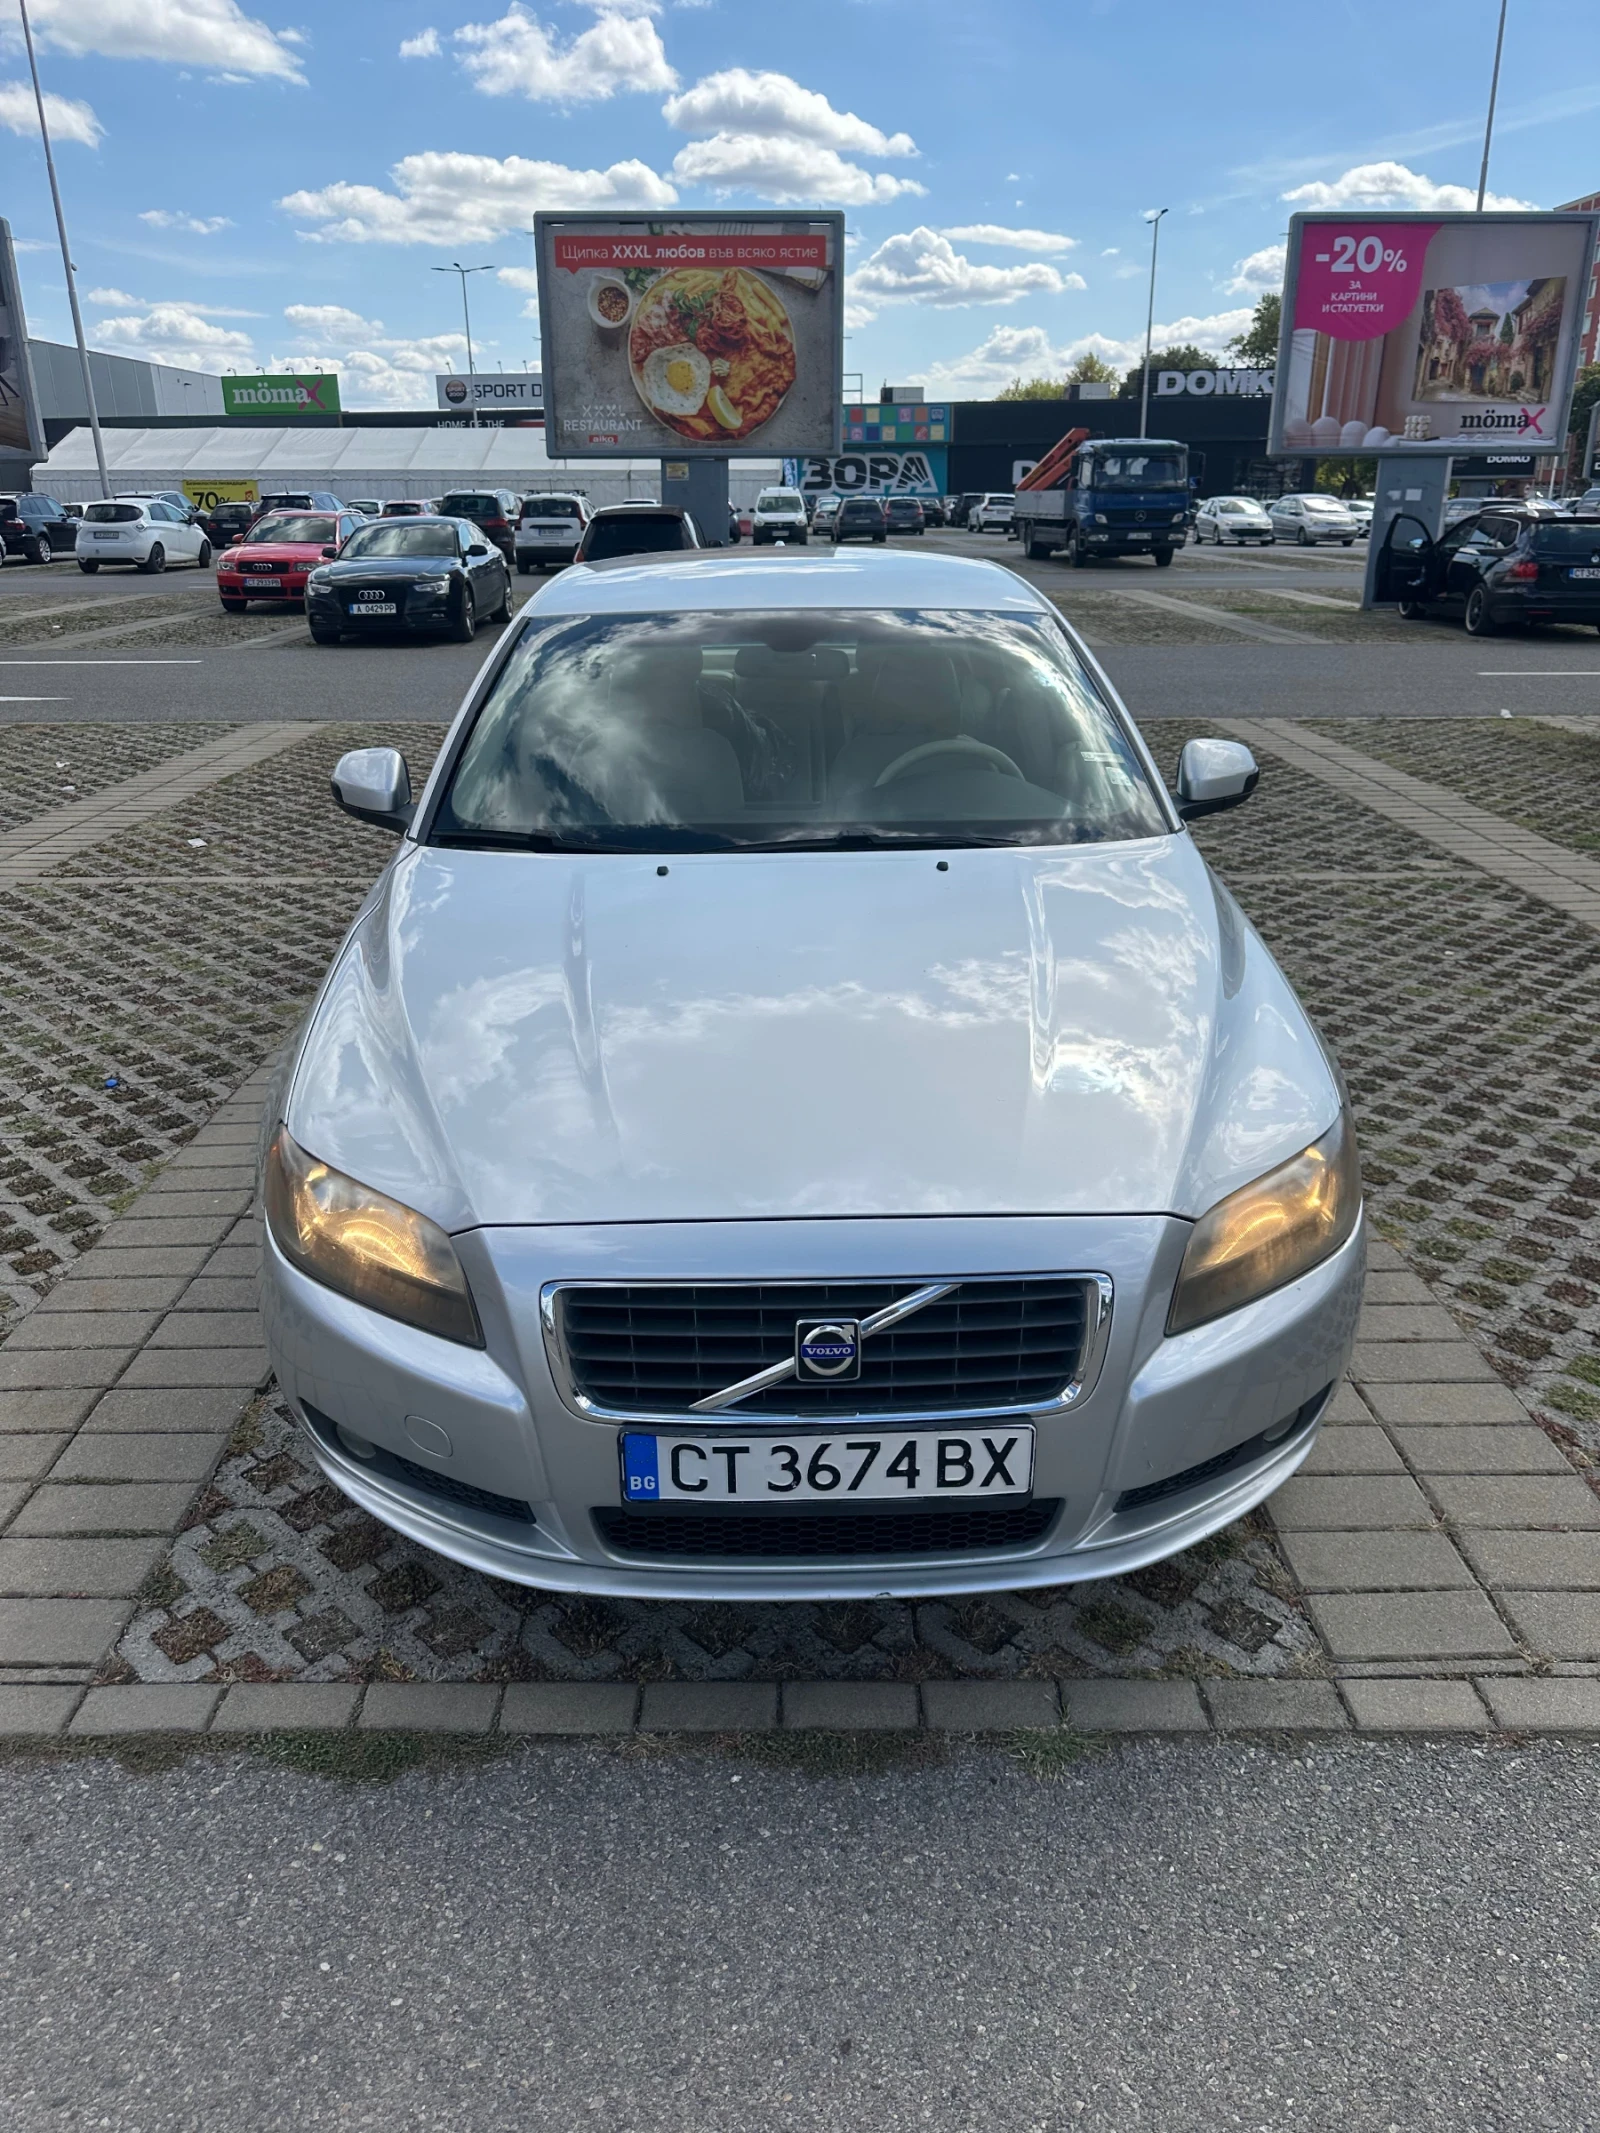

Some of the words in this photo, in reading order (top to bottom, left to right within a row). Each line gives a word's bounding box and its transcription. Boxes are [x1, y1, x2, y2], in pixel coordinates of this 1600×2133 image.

[562, 245, 608, 261] Щипка
[612, 245, 652, 258] XXXL
[655, 244, 705, 259] любов
[708, 248, 734, 258] във
[737, 248, 775, 258] всяко
[779, 248, 818, 258] ястие
[1315, 235, 1407, 273] -20%
[1349, 281, 1361, 289] ЗА
[1331, 292, 1377, 301] КАРТИНИ
[1322, 304, 1329, 312] И
[1330, 304, 1384, 312] СТАТУЕТКИ
[1157, 371, 1275, 395] DOMK
[473, 383, 527, 398] SPORT
[582, 404, 626, 418] XXXL
[563, 419, 642, 431] RESTAURANT
[593, 435, 614, 443] aiko
[802, 453, 937, 494] ЗОРА
[357, 604, 362, 612] A
[365, 603, 383, 612] 0429
[384, 603, 395, 612] PP
[805, 1347, 852, 1355] VOLVO
[669, 1443, 750, 1494] CT
[767, 1440, 921, 1492] 3674
[936, 1437, 1019, 1488] BX
[630, 1475, 656, 1491] BG
